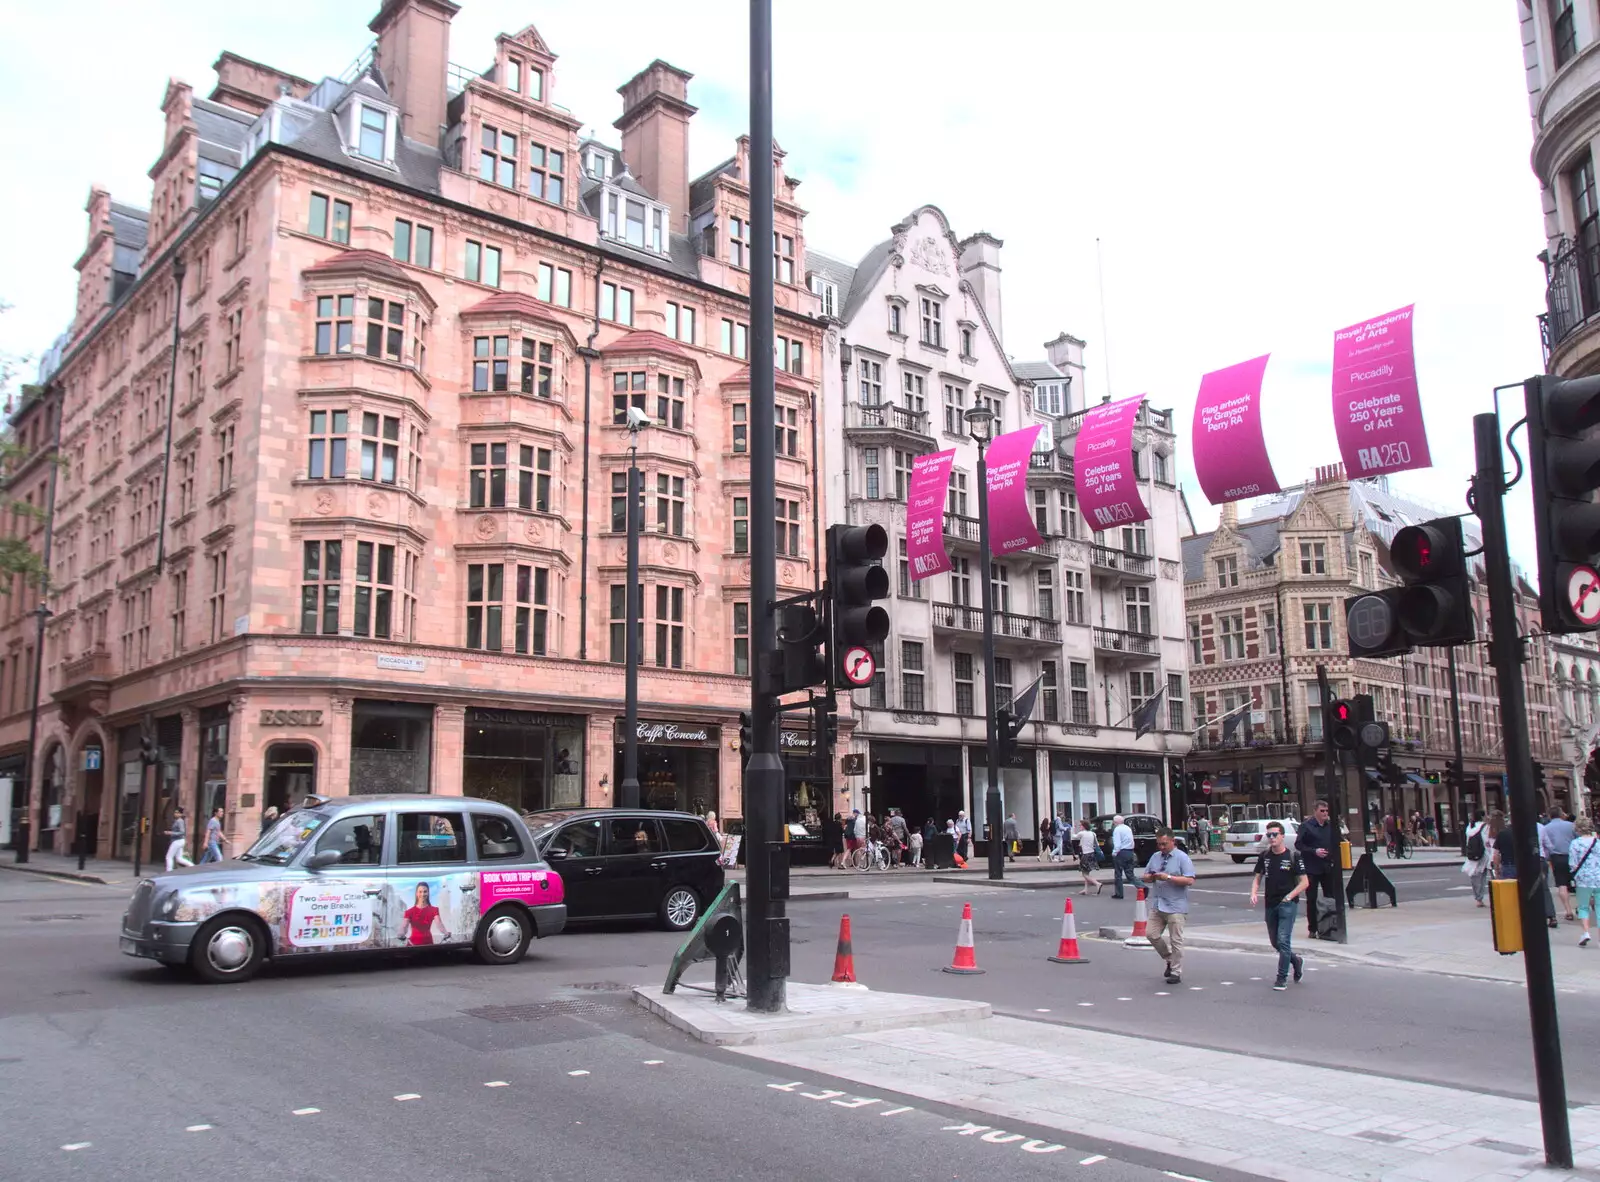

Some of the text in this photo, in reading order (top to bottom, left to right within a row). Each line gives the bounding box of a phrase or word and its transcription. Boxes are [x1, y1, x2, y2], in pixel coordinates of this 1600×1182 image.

[1336, 311, 1411, 342] Royal Academy
[1355, 326, 1388, 343] of Arts
[1350, 364, 1394, 383] Piccadilly
[1201, 393, 1251, 416] Flag artwork
[1349, 393, 1401, 411] Celebrate
[1202, 404, 1249, 425] by Grayson
[1350, 404, 1404, 423] 250 Years
[1207, 414, 1243, 432] Perry RA
[1363, 417, 1394, 432] of Art
[1087, 437, 1117, 452] Piccadilly
[1358, 441, 1411, 470] RA250
[985, 460, 1022, 476] Flag artwork
[1084, 462, 1120, 477] Celebrate
[986, 469, 1018, 485] by Grayson
[1085, 472, 1122, 487] 250 Years
[989, 478, 1014, 493] Perry RA
[1095, 483, 1116, 495] of Art
[1224, 483, 1260, 498] #RA250
[1094, 502, 1134, 525] RA250
[911, 518, 934, 530] Celebrate
[911, 526, 934, 539] 250 Years
[916, 537, 921, 545] of
[1002, 537, 1028, 549] #RA250
[914, 552, 940, 574] RA250
[379, 656, 413, 665] PICCADILLY
[259, 709, 324, 727] ESSIE
[474, 711, 577, 726] ESSIE CARPETS
[664, 724, 707, 741] Concerto
[483, 873, 501, 883] BOOK
[501, 872, 518, 882] YOUR
[518, 871, 531, 882] TRIP
[299, 895, 317, 903] Two
[318, 893, 342, 903] Sunny
[311, 903, 329, 911] One
[304, 915, 331, 926] TEL
[294, 925, 369, 940] JERUSALEM
